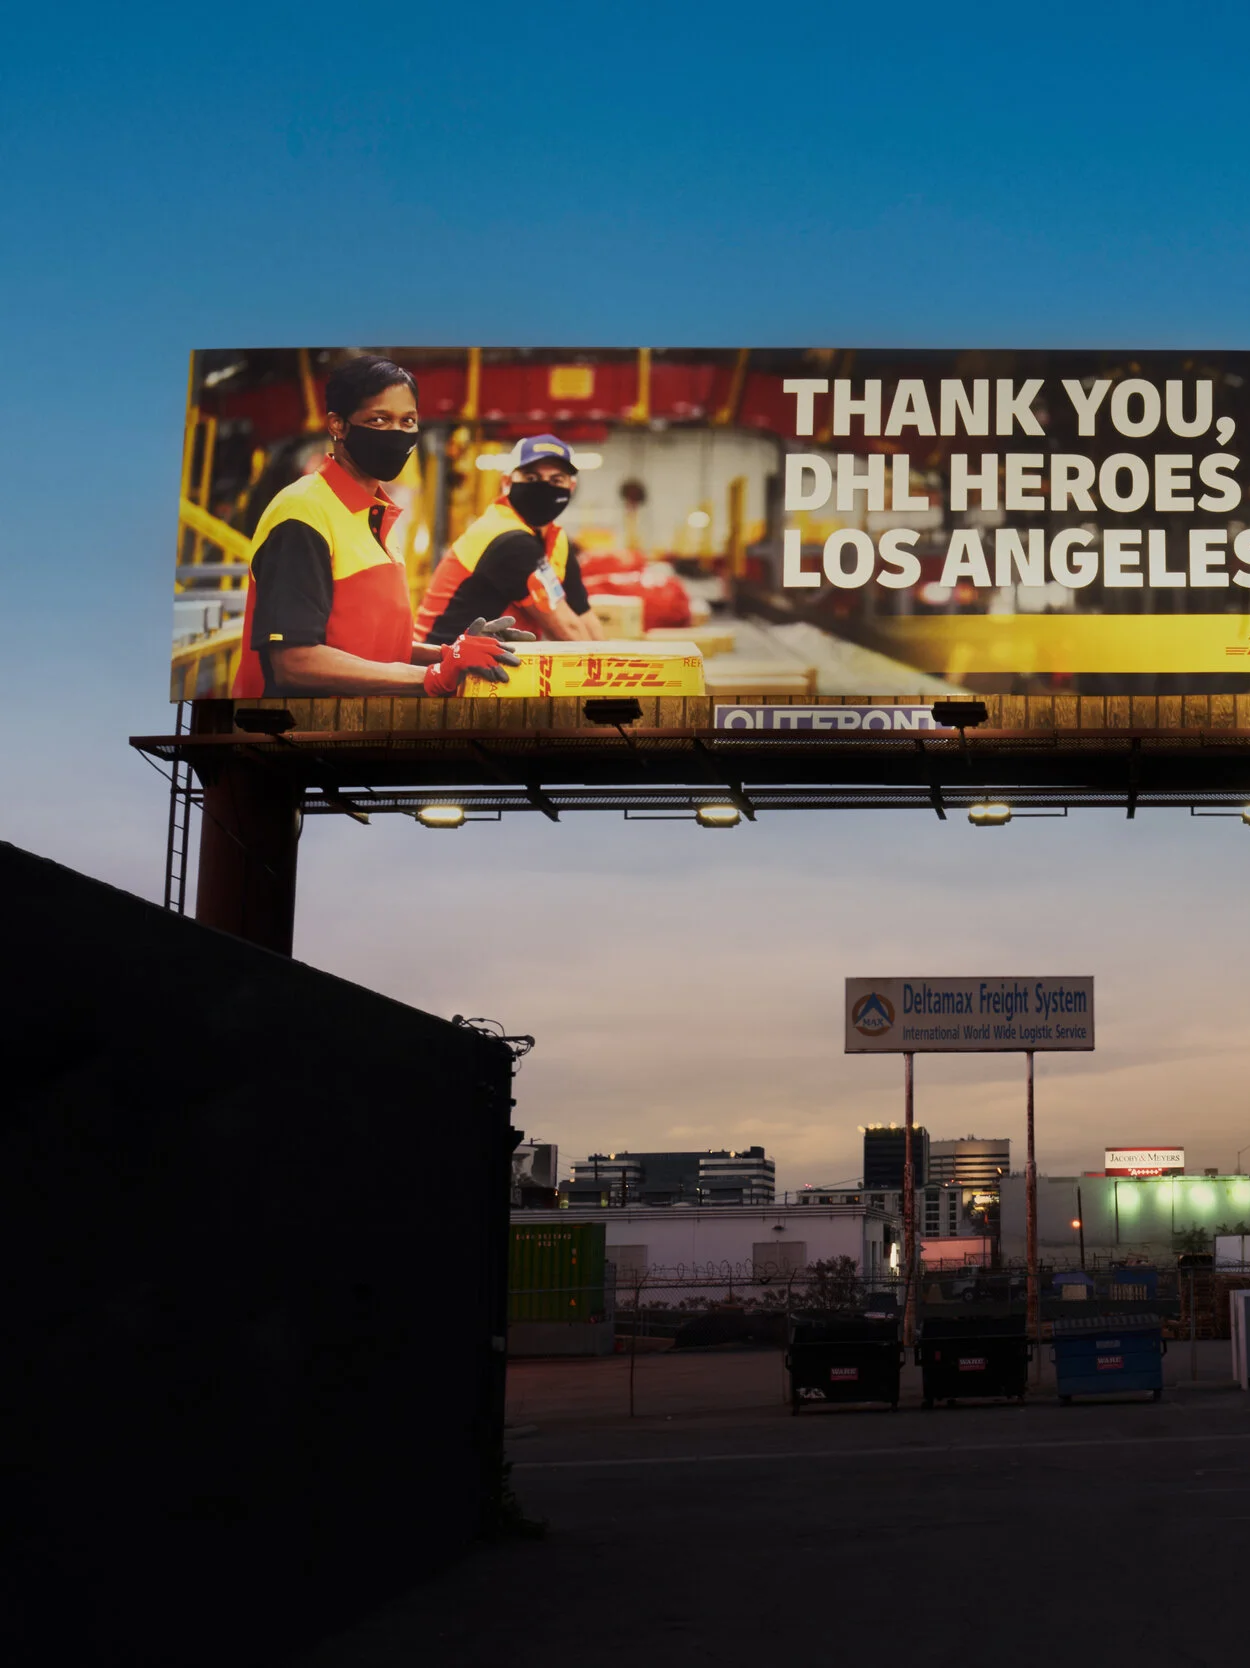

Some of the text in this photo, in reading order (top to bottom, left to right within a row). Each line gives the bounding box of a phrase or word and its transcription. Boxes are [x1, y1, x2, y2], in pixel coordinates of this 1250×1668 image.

[782, 378, 1236, 446] THANK YOU,
[783, 453, 930, 512] DHL
[950, 453, 1242, 513] HEROES
[782, 528, 923, 589] LOS
[903, 983, 1087, 1021] Deltamax Freight System
[862, 1017, 884, 1027] MAX
[903, 1024, 1087, 1043] International World Wide Logistic Service
[1148, 1153, 1180, 1162] MEYERS
